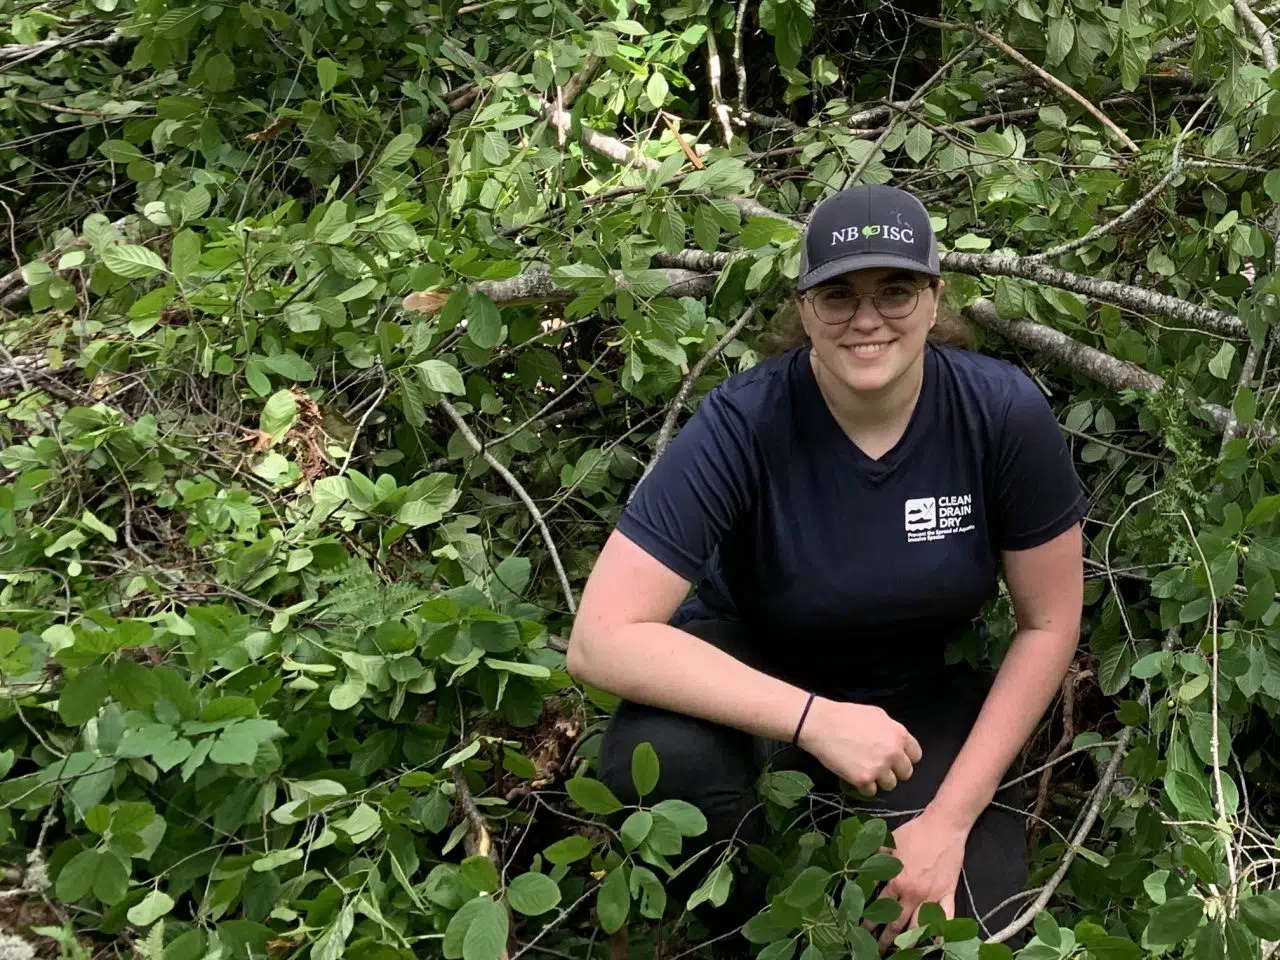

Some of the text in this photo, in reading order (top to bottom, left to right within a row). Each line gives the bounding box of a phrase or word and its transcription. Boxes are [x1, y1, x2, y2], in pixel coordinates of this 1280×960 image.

[831, 225, 915, 245] NB ISC
[938, 494, 972, 506] CLEAN
[939, 504, 972, 517] DRAIN
[939, 517, 962, 528] DRY
